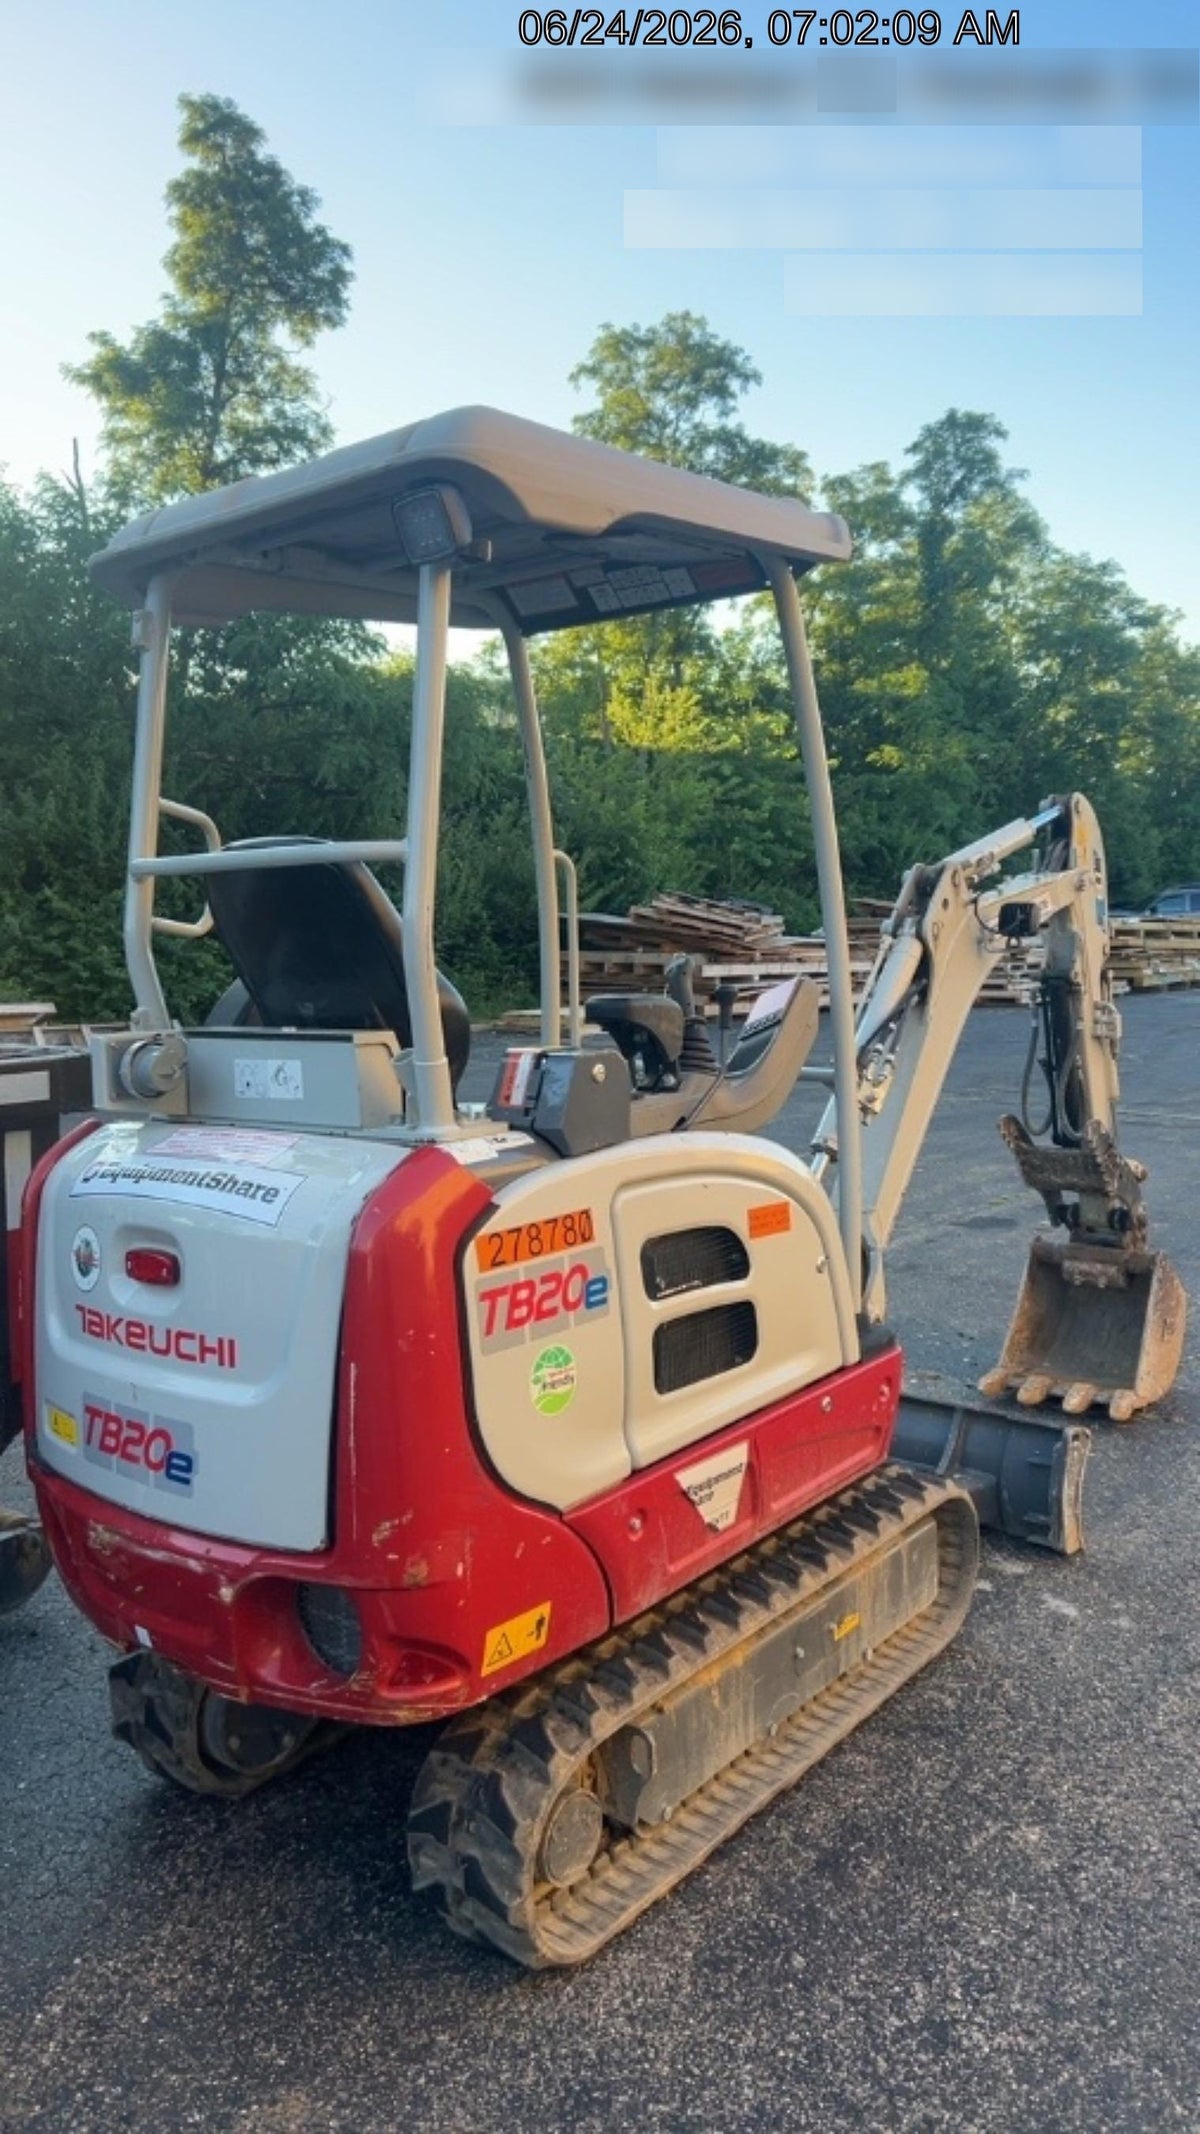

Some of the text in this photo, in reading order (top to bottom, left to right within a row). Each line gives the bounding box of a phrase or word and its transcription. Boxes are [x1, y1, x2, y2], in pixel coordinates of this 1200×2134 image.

[99, 1162, 281, 1204] EquipmentShare
[488, 1209, 594, 1268] 278780
[478, 1262, 609, 1338] TB20e
[83, 1405, 194, 1486] TB20e
